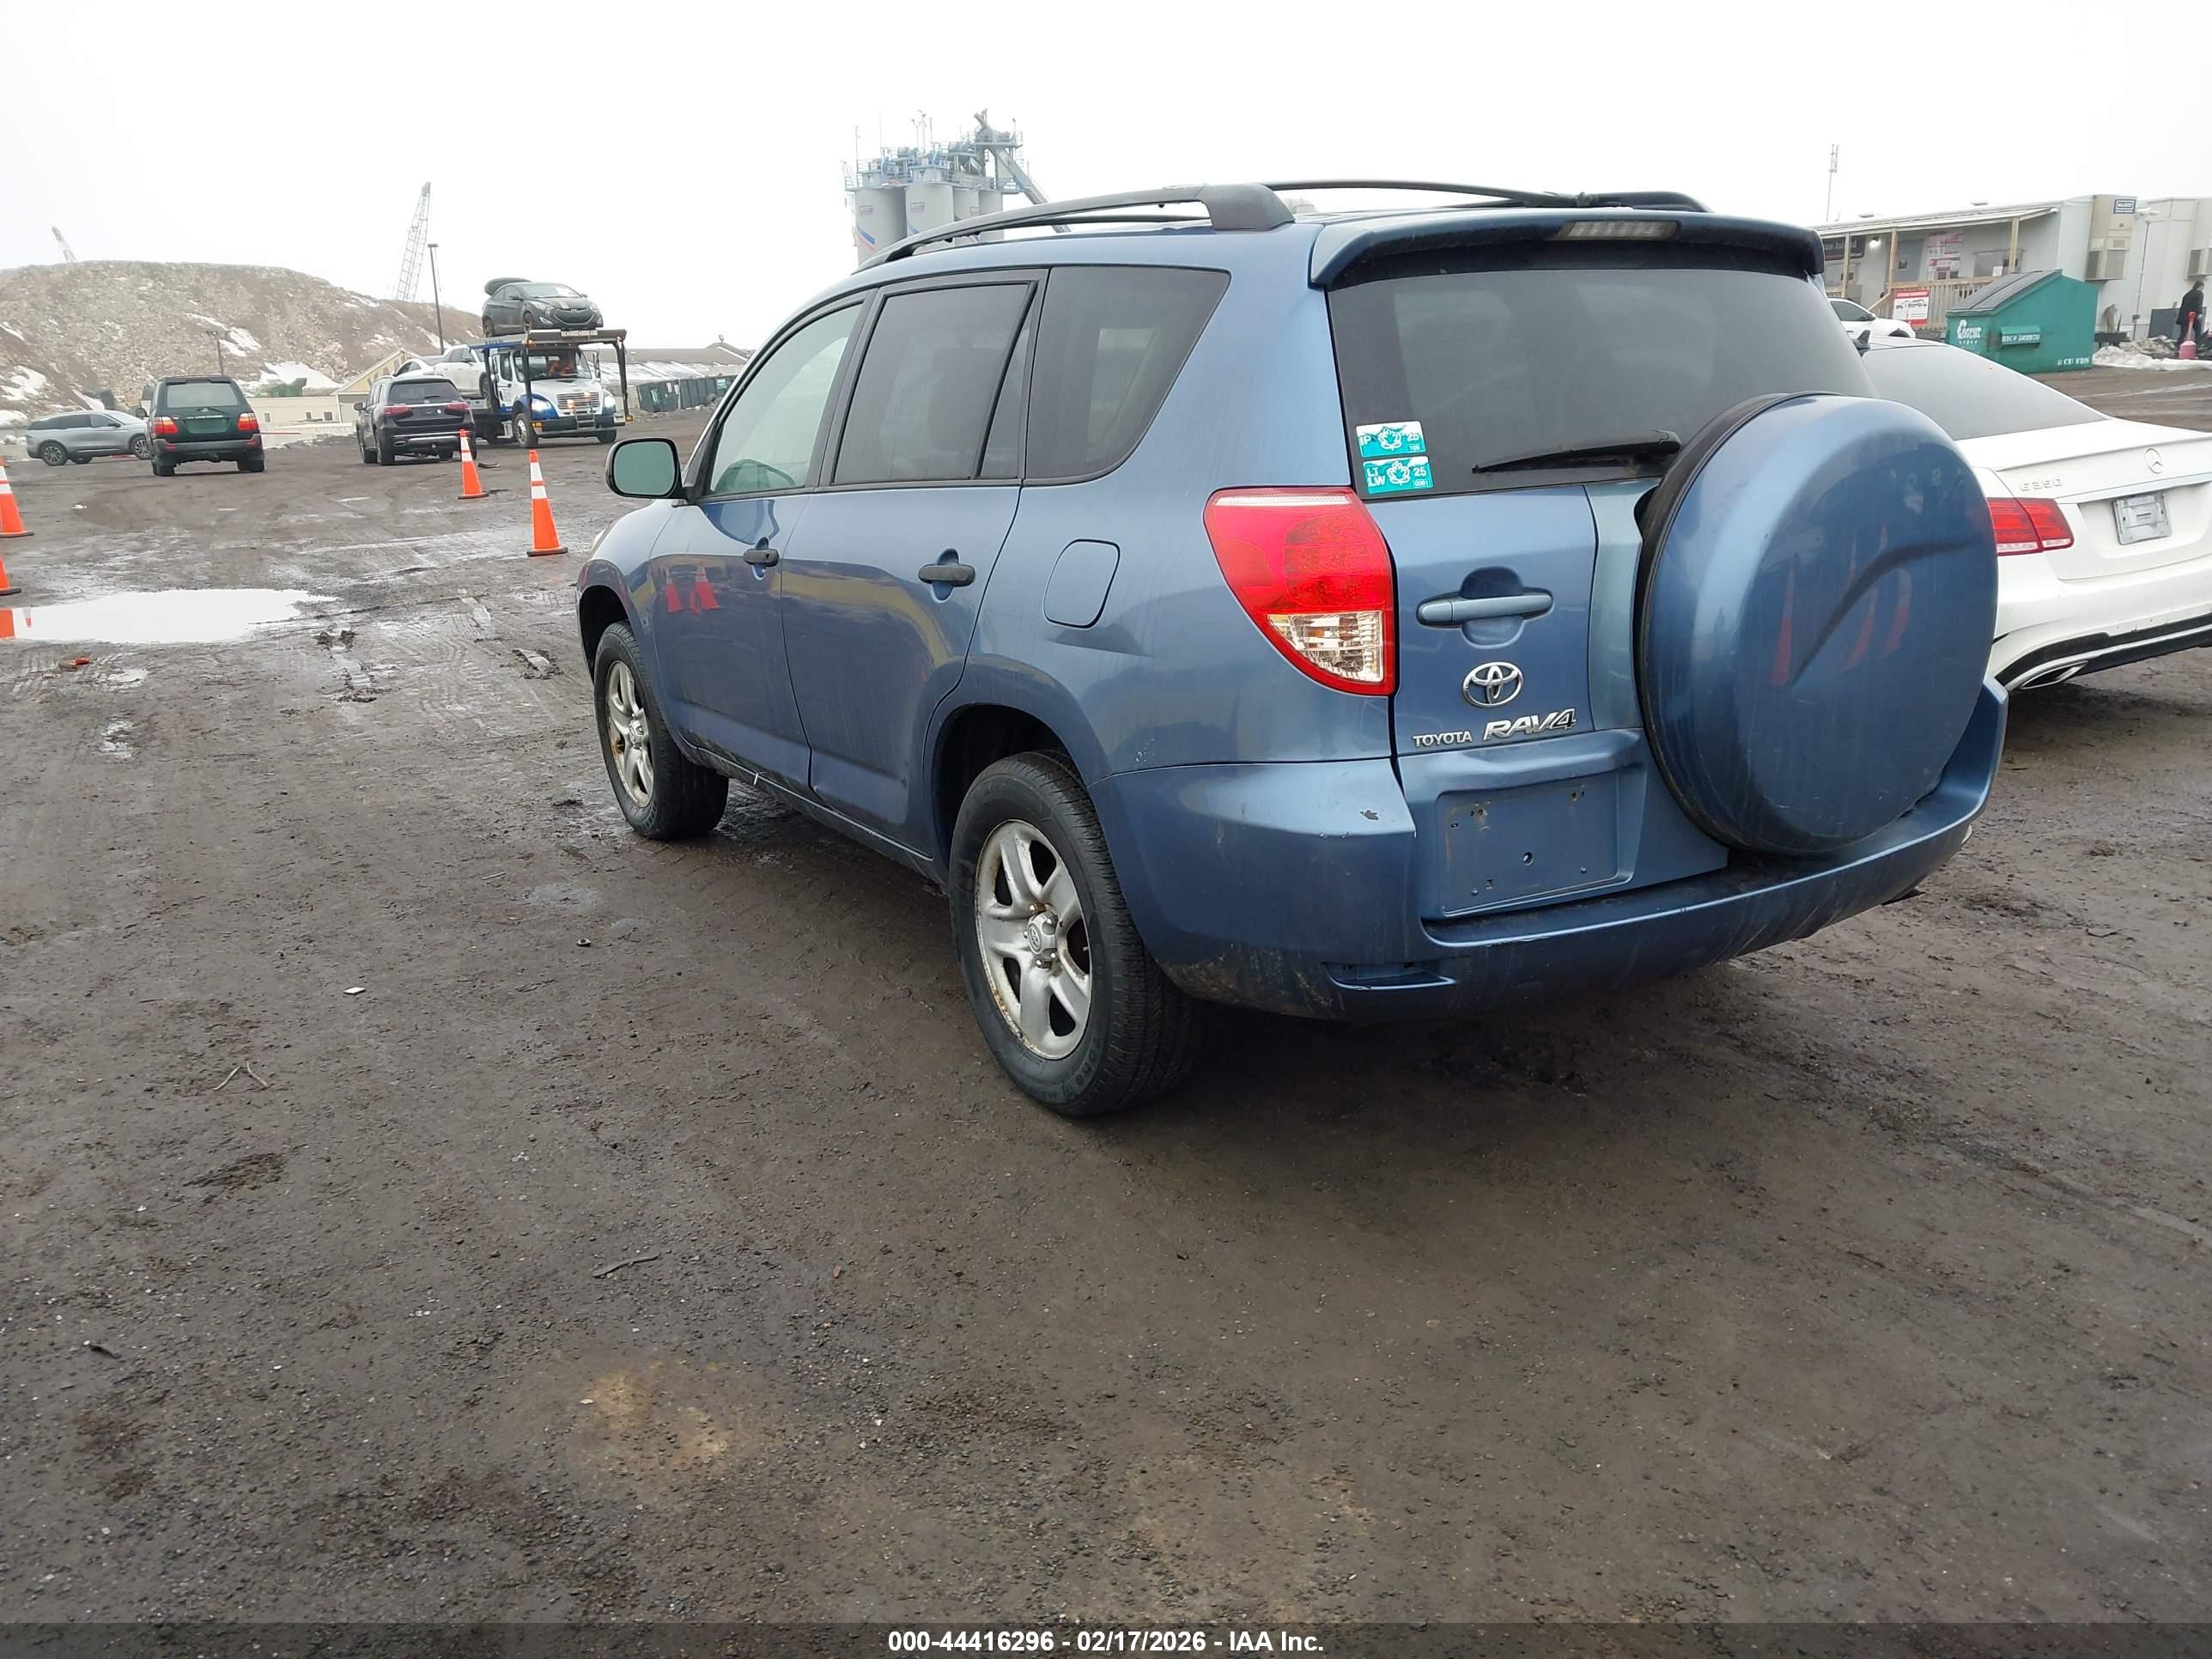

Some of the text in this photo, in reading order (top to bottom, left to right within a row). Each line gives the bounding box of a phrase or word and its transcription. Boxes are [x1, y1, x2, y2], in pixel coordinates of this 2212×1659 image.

[1366, 466, 1378, 477] LT
[1413, 466, 1426, 477] 25
[1367, 475, 1385, 486] LW
[1484, 708, 1577, 741] RAV4
[1413, 731, 1474, 748] TOYOTA
